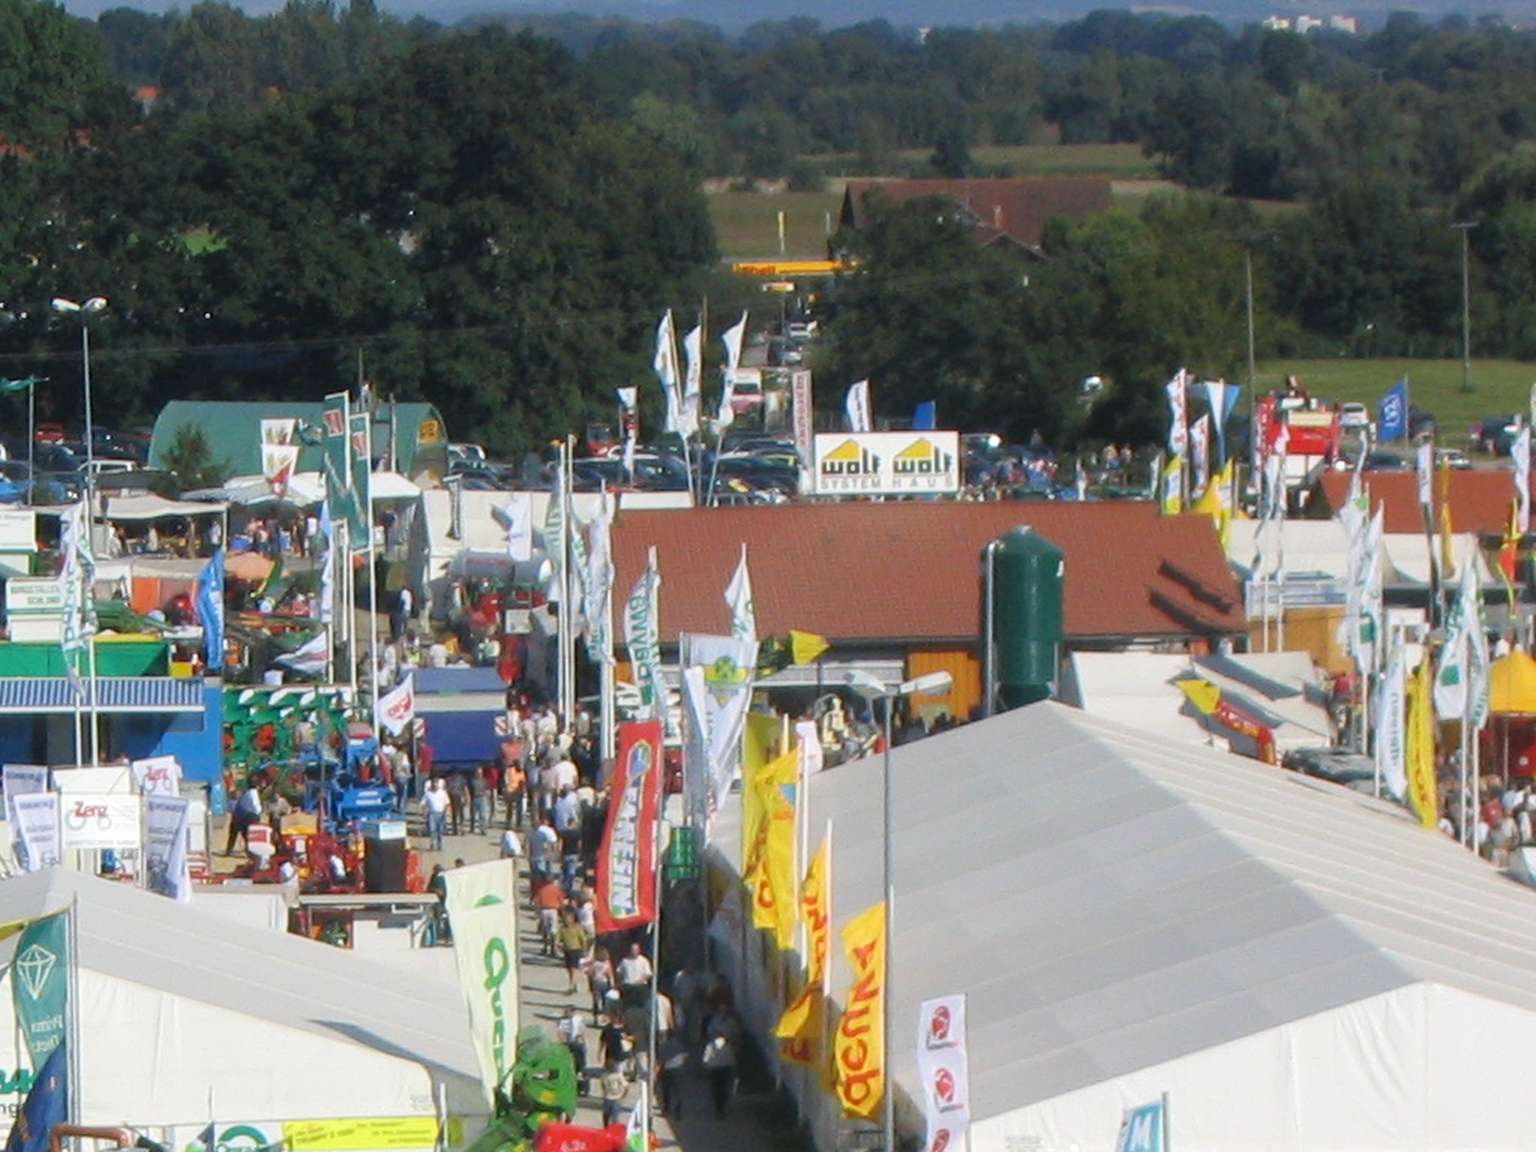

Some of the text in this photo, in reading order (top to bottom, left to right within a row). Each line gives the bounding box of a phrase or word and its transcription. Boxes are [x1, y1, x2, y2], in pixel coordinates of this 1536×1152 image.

[822, 447, 880, 474] wolf
[894, 445, 952, 473] wolf
[821, 479, 881, 490] SYSTEM
